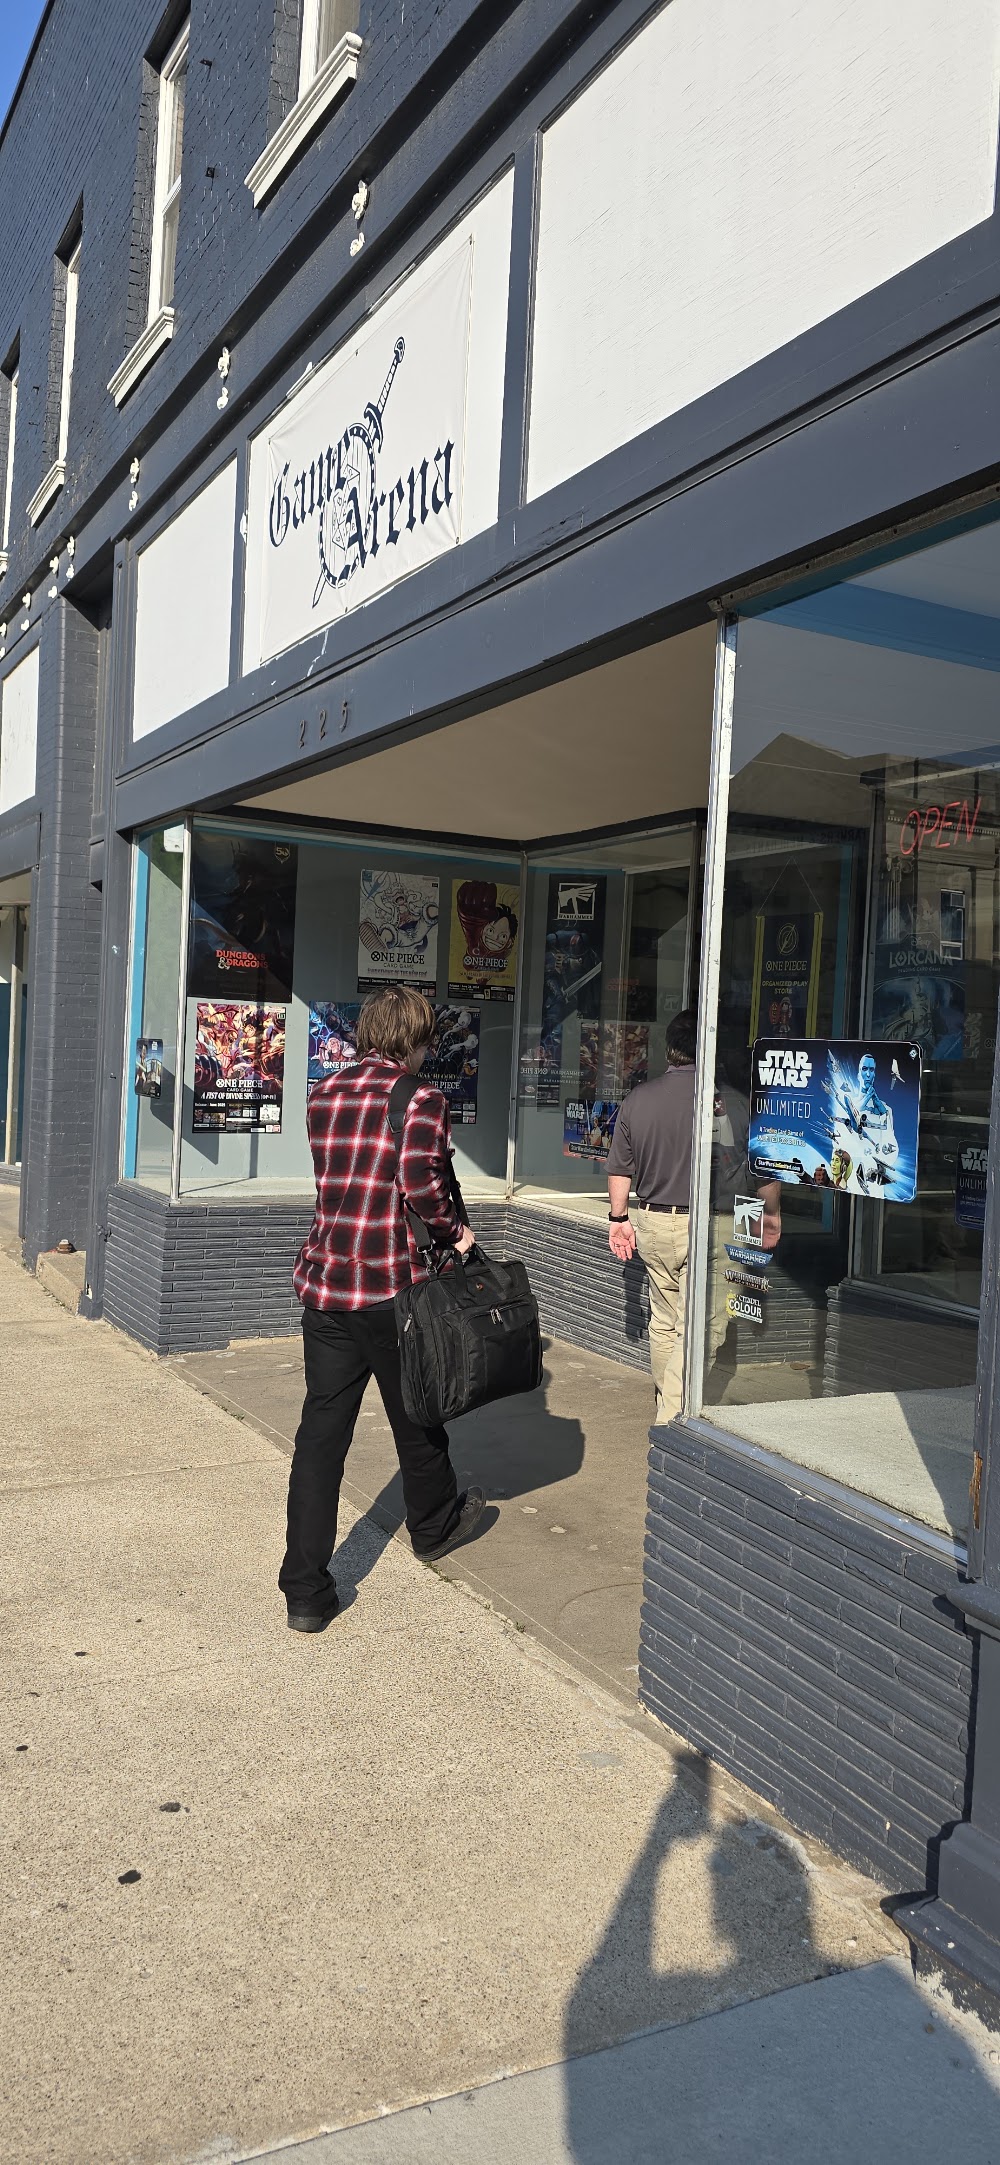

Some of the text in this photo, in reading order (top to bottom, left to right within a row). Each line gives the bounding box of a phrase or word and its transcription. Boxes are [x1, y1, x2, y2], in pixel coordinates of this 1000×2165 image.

[269, 427, 351, 548] Game
[346, 439, 455, 568] Arena
[299, 699, 350, 749] 225
[900, 795, 983, 855] OPEN
[216, 950, 265, 961] DUNGEONS
[371, 951, 425, 965] ONE PIECE
[463, 955, 509, 968] ONE PIECE
[889, 949, 953, 968] LORCANA
[226, 958, 268, 968] DRAGONS
[766, 960, 807, 972] ONE PIECE
[323, 1061, 340, 1069] ONE
[759, 1050, 813, 1070] STAR
[216, 1079, 263, 1088] ONE PIECE
[759, 1067, 812, 1088] WARS
[440, 1081, 461, 1090] PIECE
[566, 1103, 585, 1112] STAR
[757, 1098, 811, 1119] UNLIMITED
[566, 1110, 585, 1120] WARS
[961, 1148, 988, 1159] STA
[729, 1248, 767, 1264] WARHAMMER
[738, 1295, 762, 1307] CITADEL
[729, 1299, 762, 1318] COLOUR
